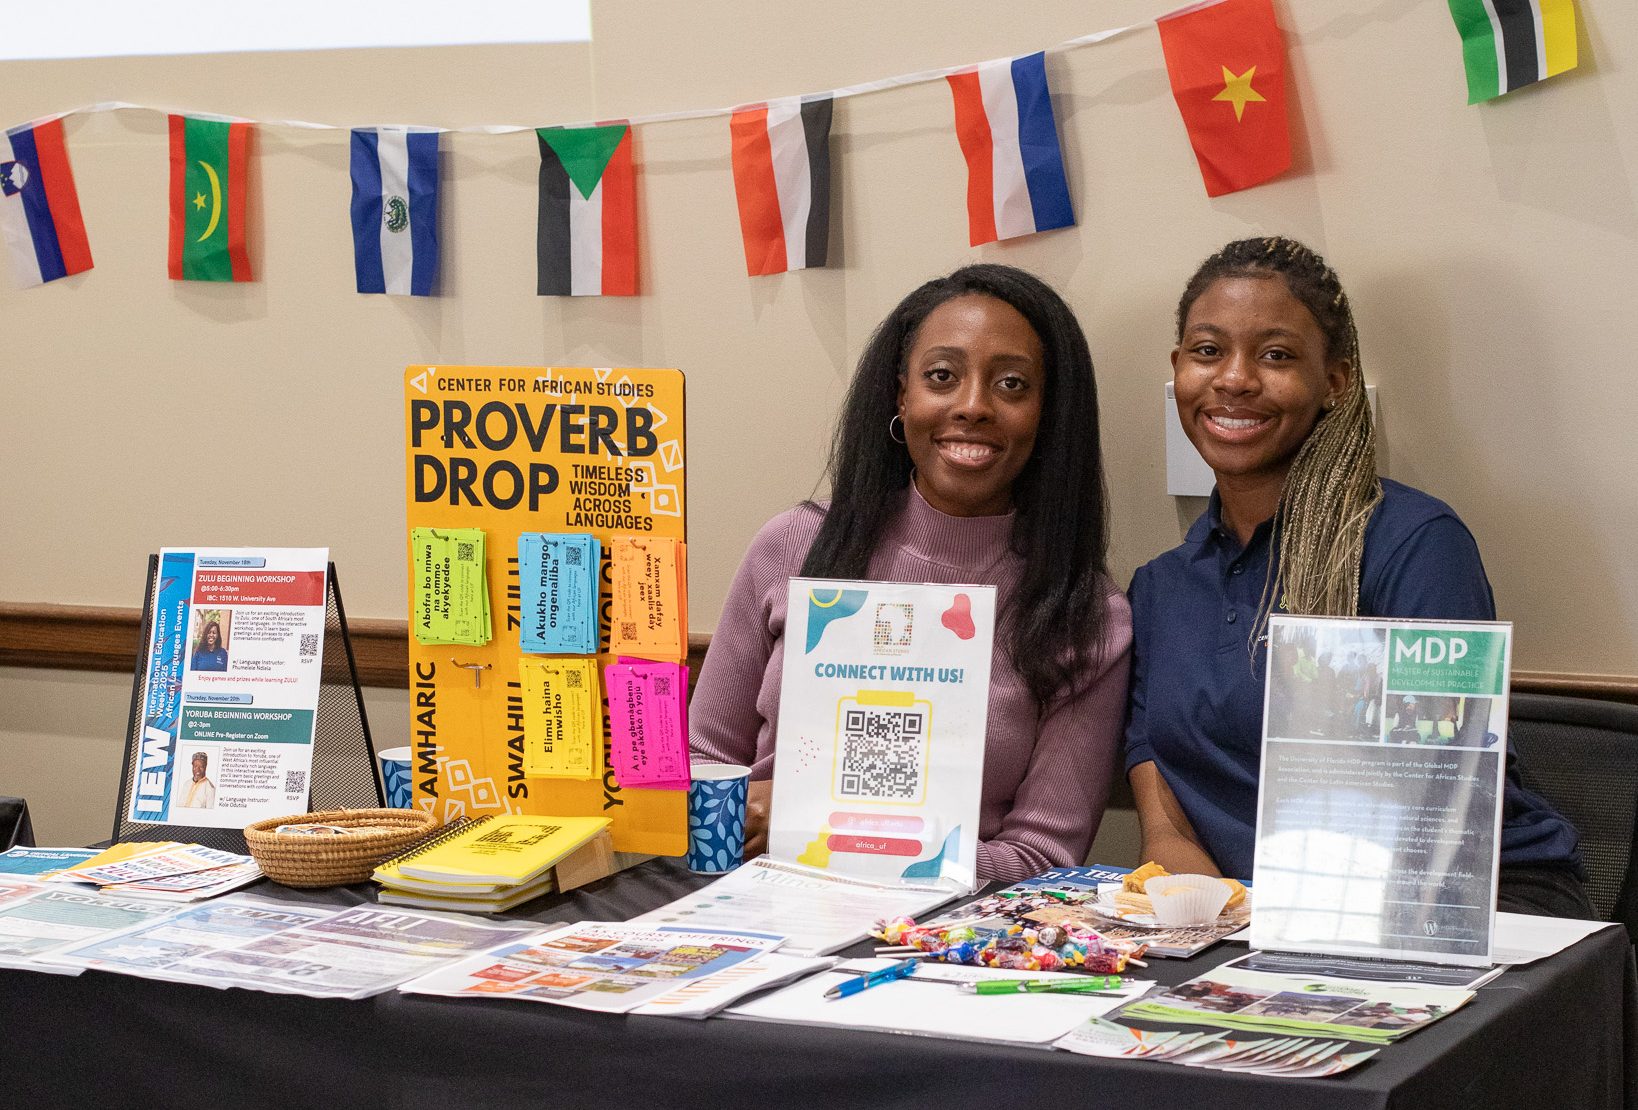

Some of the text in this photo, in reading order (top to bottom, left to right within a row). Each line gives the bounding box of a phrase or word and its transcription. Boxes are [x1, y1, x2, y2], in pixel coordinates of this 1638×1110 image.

[438, 378, 654, 398] CENTER FOR AFRICAN STUDIES
[411, 399, 658, 458] PROVERB
[414, 454, 560, 512] DROP
[572, 464, 644, 483] TIMELESS
[570, 480, 630, 498] WISDOM
[573, 498, 632, 514] ACROSS
[566, 512, 653, 532] LANGUAGES
[423, 576, 431, 589] bo
[441, 557, 451, 620] akyekyedee
[536, 544, 550, 640] Akukho mango
[549, 559, 559, 628] ongenaliba
[638, 582, 646, 601] jeex
[423, 593, 431, 629] Abofra
[434, 600, 440, 612] na
[656, 600, 664, 627] dafay
[148, 608, 167, 718] International Education
[166, 600, 184, 719] African Languages Events
[1395, 636, 1468, 664] MDP
[814, 663, 964, 684] CONNECT WITH US!
[1391, 678, 1484, 689] DEVELOPMENT PRACTICE
[1392, 667, 1420, 677] MASTER
[1432, 669, 1479, 678] SUSTAINABLE
[156, 665, 169, 718] Week 2025
[186, 710, 213, 718] YORUBA
[214, 711, 252, 720] BEGINNING
[542, 681, 553, 753] Elimu haina
[553, 694, 563, 740] mwisho
[216, 732, 245, 740] Pre-Register
[416, 662, 438, 798] AMHARIC
[137, 726, 170, 812] IEW
[856, 842, 886, 850] africa_uf
